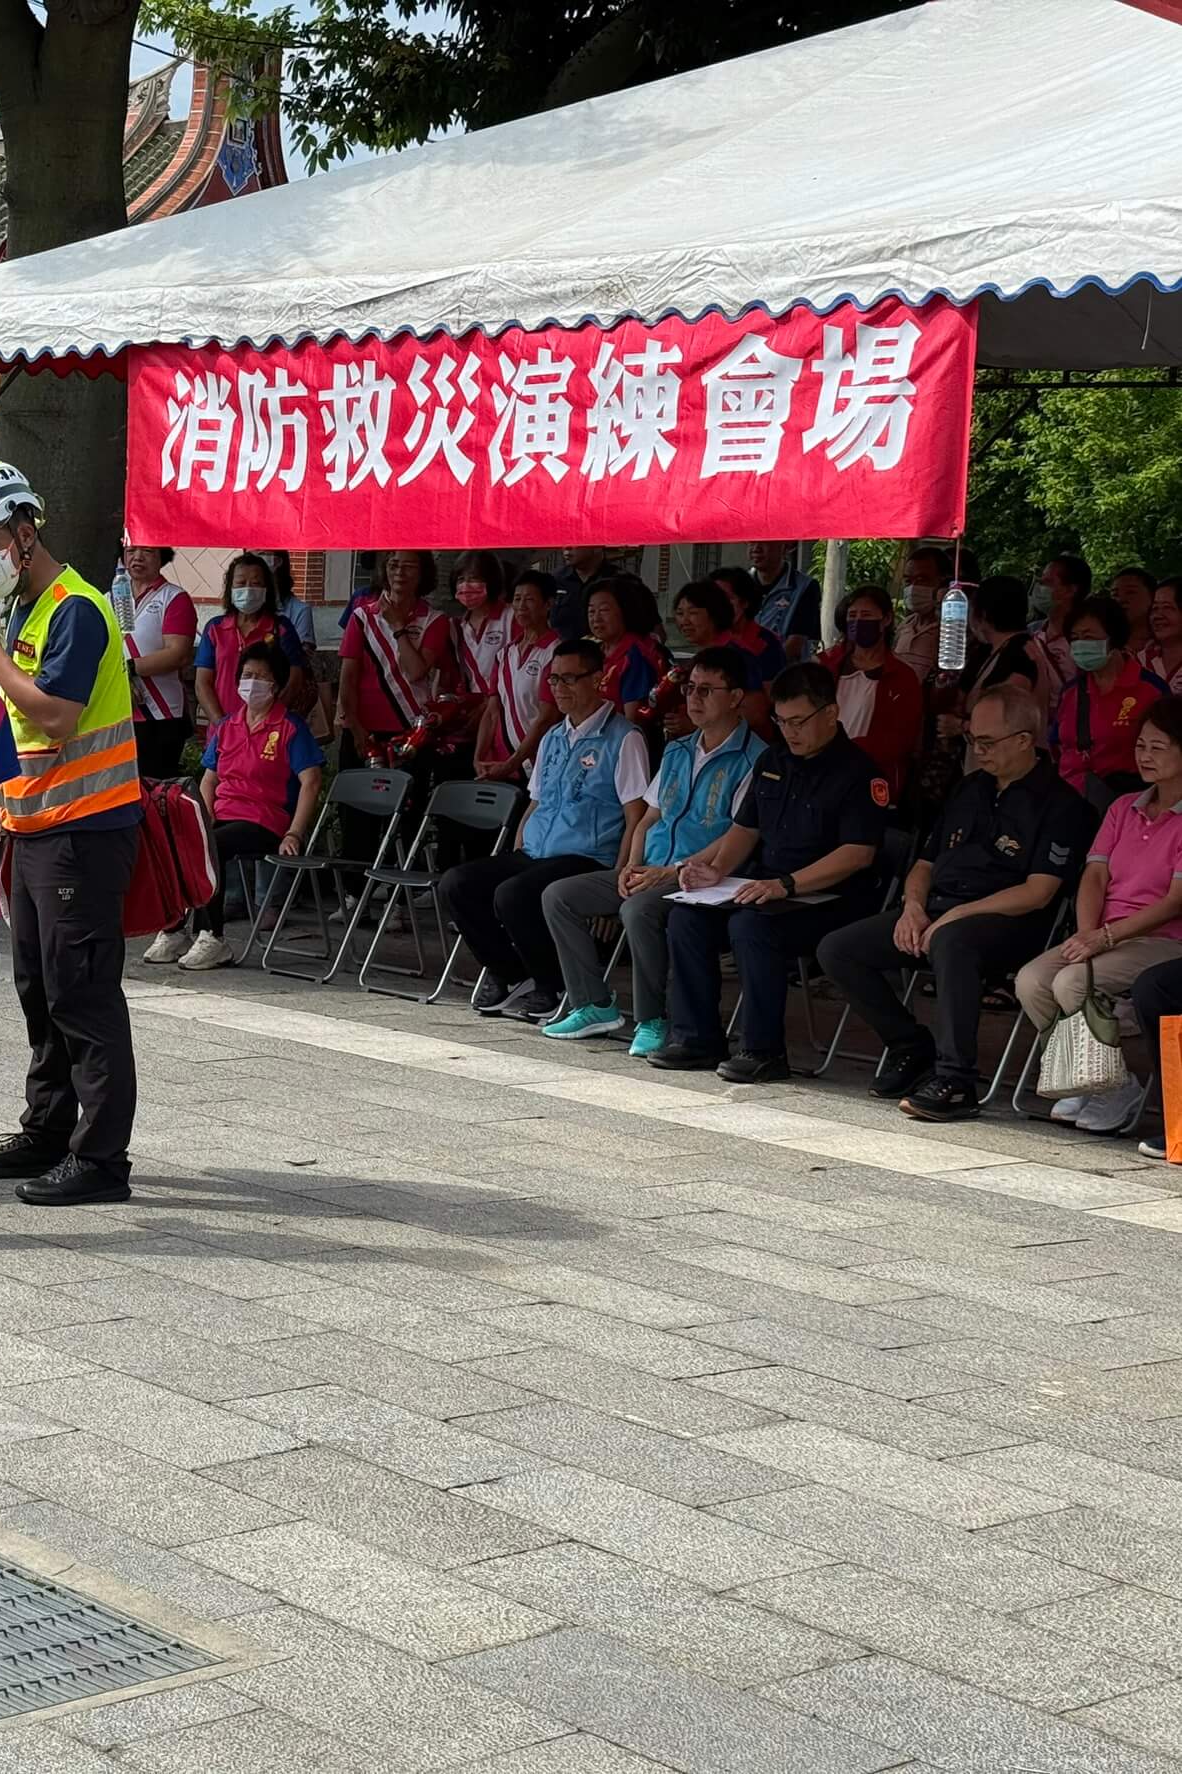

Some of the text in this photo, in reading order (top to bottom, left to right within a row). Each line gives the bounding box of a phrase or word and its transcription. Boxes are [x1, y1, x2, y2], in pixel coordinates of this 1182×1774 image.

[159, 319, 922, 492] 消防救災演練會場
